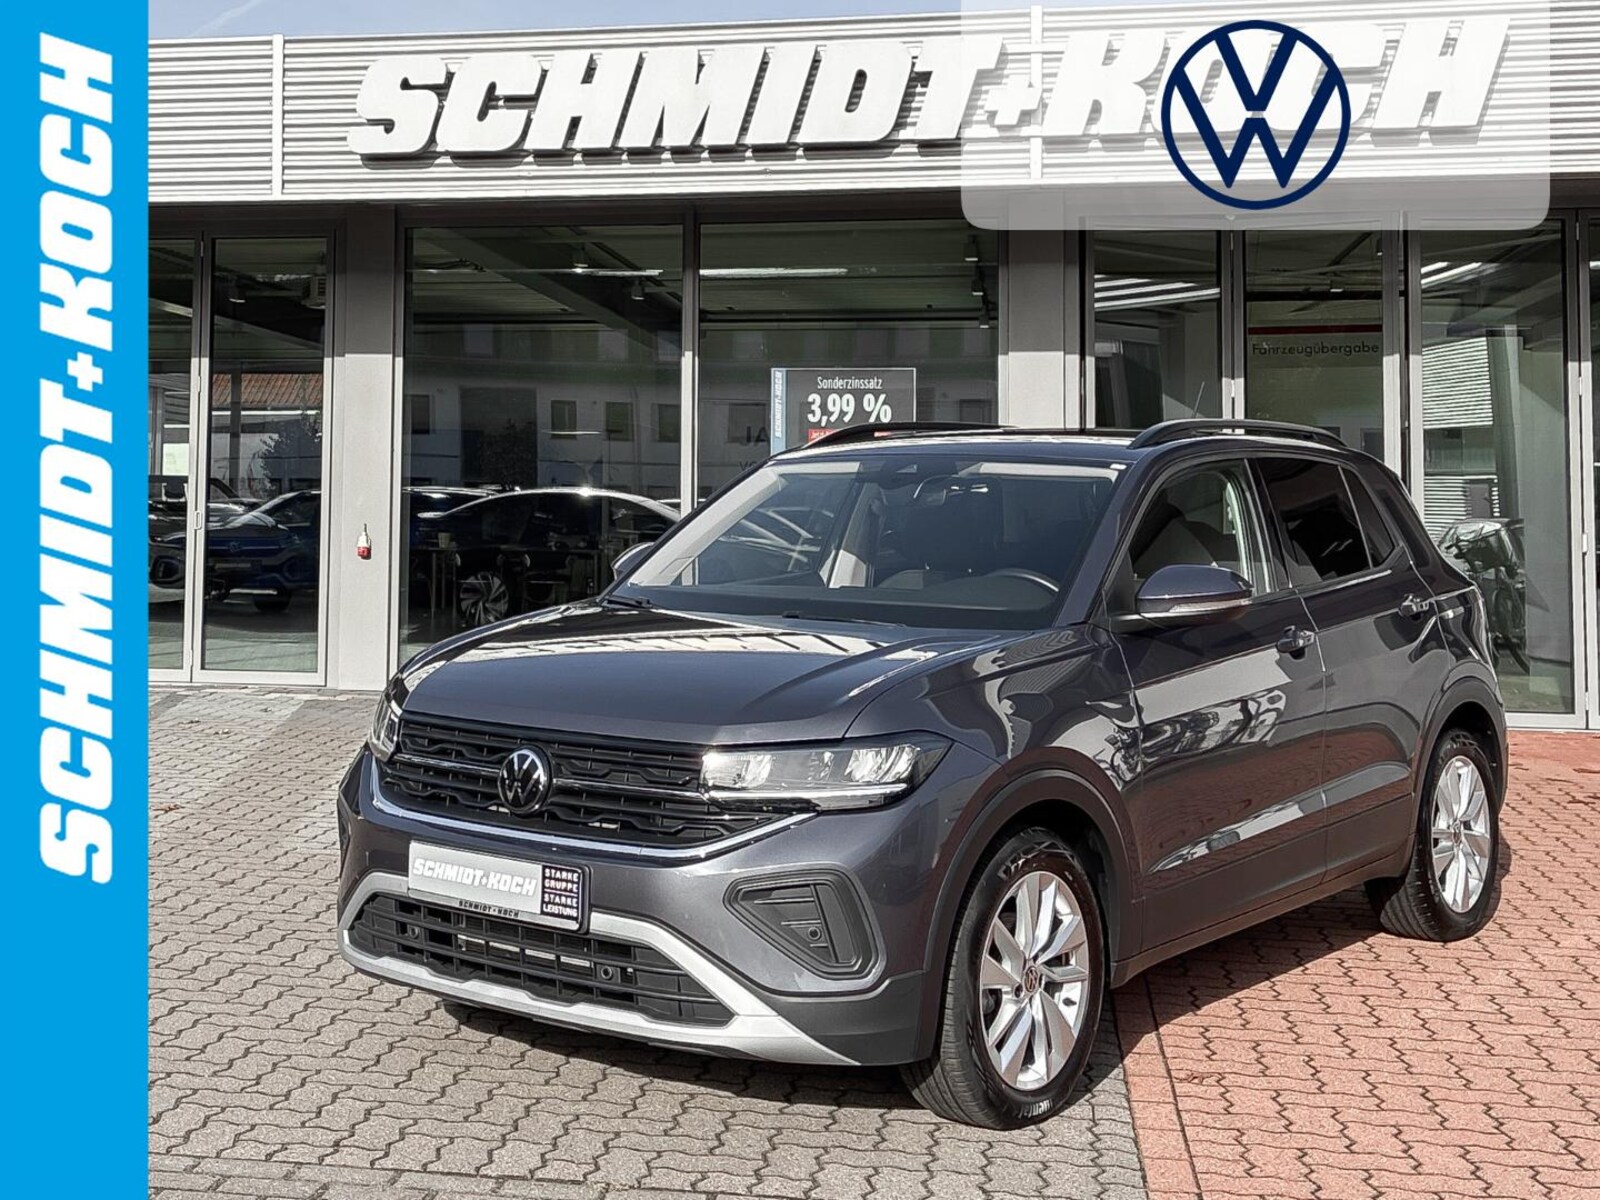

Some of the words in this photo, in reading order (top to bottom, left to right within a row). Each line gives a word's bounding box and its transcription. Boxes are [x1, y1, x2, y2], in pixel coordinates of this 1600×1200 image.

[346, 17, 1510, 156] SCHMIDT+KOCH
[1252, 341, 1380, 357] Fahrzeugübergabe
[817, 376, 883, 390] Sonderzinssatz
[807, 393, 855, 427] 3,99
[862, 393, 892, 423] %
[413, 858, 538, 896] SCHMIDT+KOCH
[545, 868, 579, 882] STARKE
[544, 879, 578, 892] GRUPPE
[544, 893, 578, 907] STARKE
[543, 903, 578, 917] LEISTUNG
